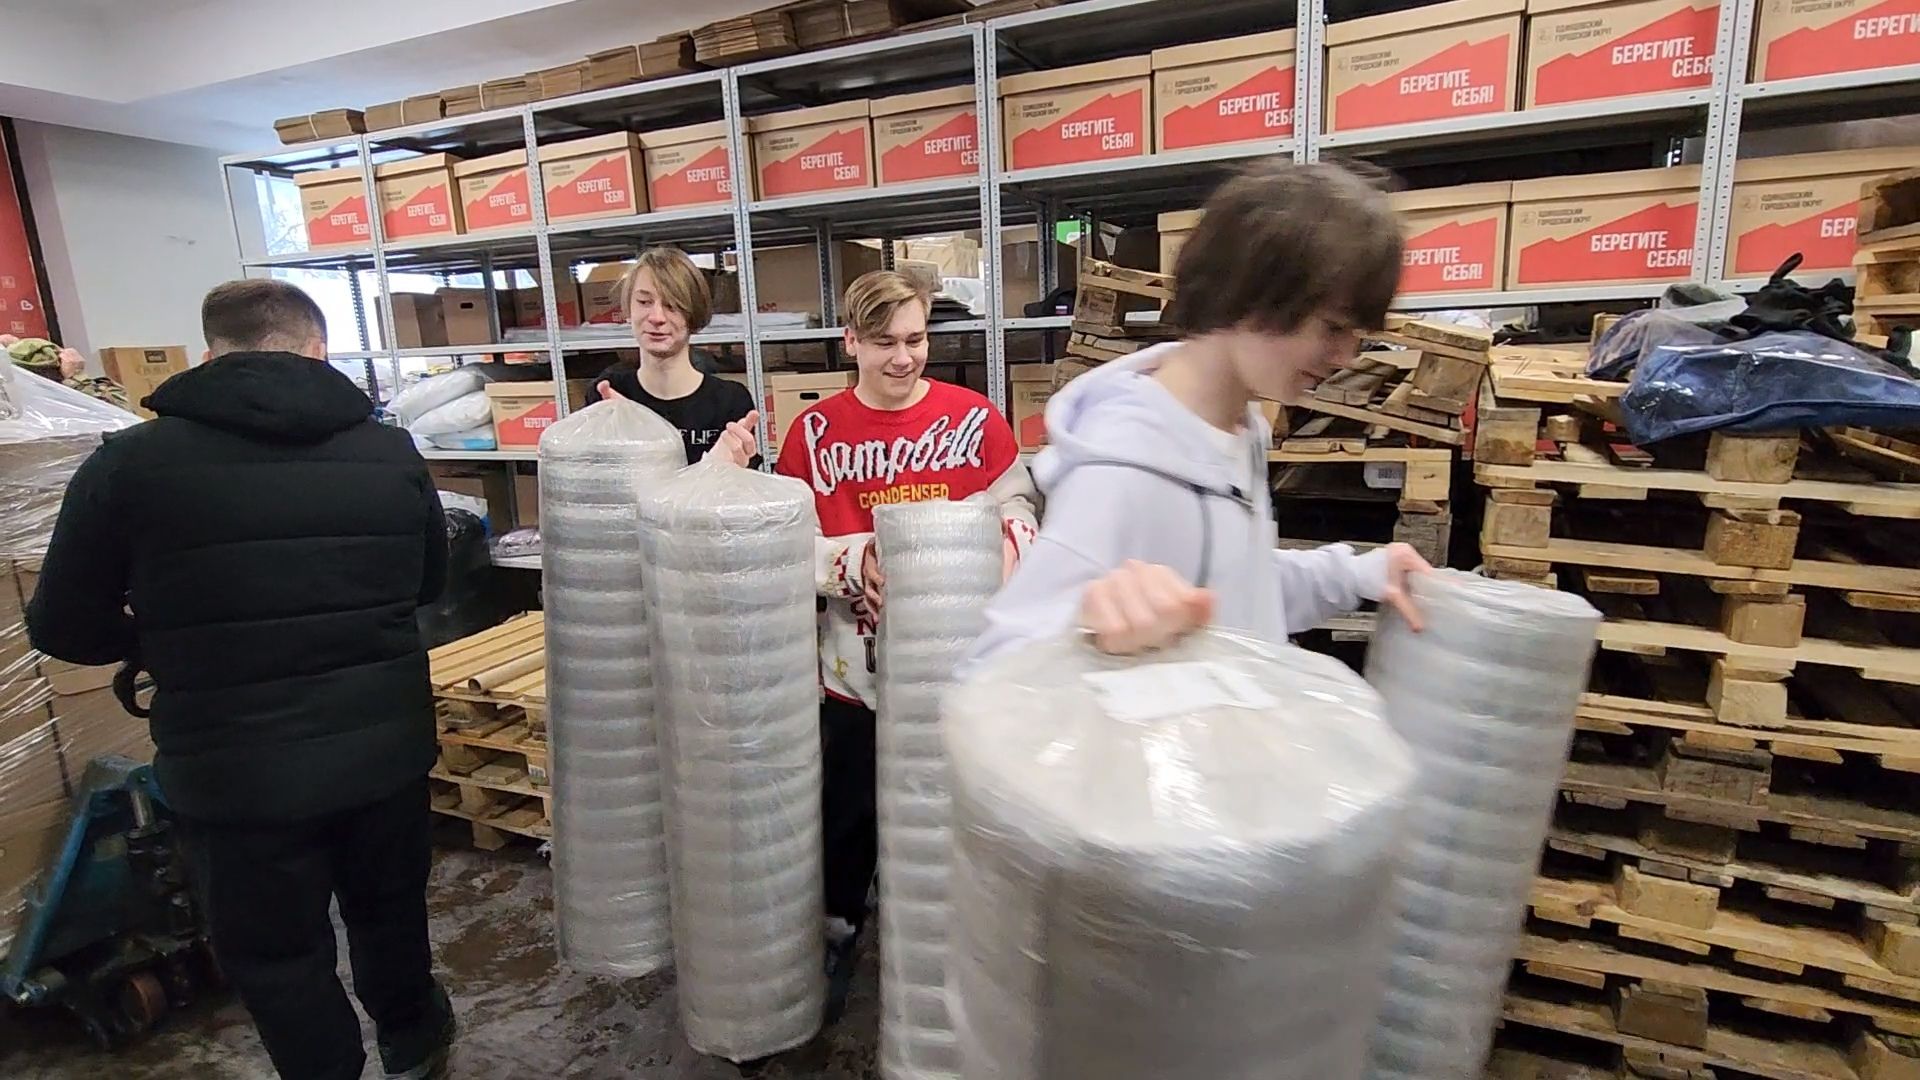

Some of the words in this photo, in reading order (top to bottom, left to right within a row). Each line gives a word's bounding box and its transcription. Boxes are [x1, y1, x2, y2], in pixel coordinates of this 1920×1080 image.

[1612, 36, 1694, 65] БЕРЕГИТЕ
[1400, 69, 1471, 95] БЕРЕГИТЕ
[1219, 92, 1280, 116] БЕРЕГИТЕ
[1452, 85, 1494, 107] СЕБЯ!
[1062, 117, 1115, 139] БЕРЕГИТЕ
[924, 135, 972, 154] БЕРЕГИТЕ
[1102, 132, 1134, 150] СЕБЯ!
[801, 152, 843, 170] БЕРЕГИТЕ
[1820, 216, 1858, 238] БЕР
[1591, 230, 1668, 252] БЕРЕГИТЕ
[1647, 249, 1692, 268] СЕБЯ!
[1443, 263, 1483, 281] СЕБЯ!
[858, 483, 949, 509] CONDENSED
